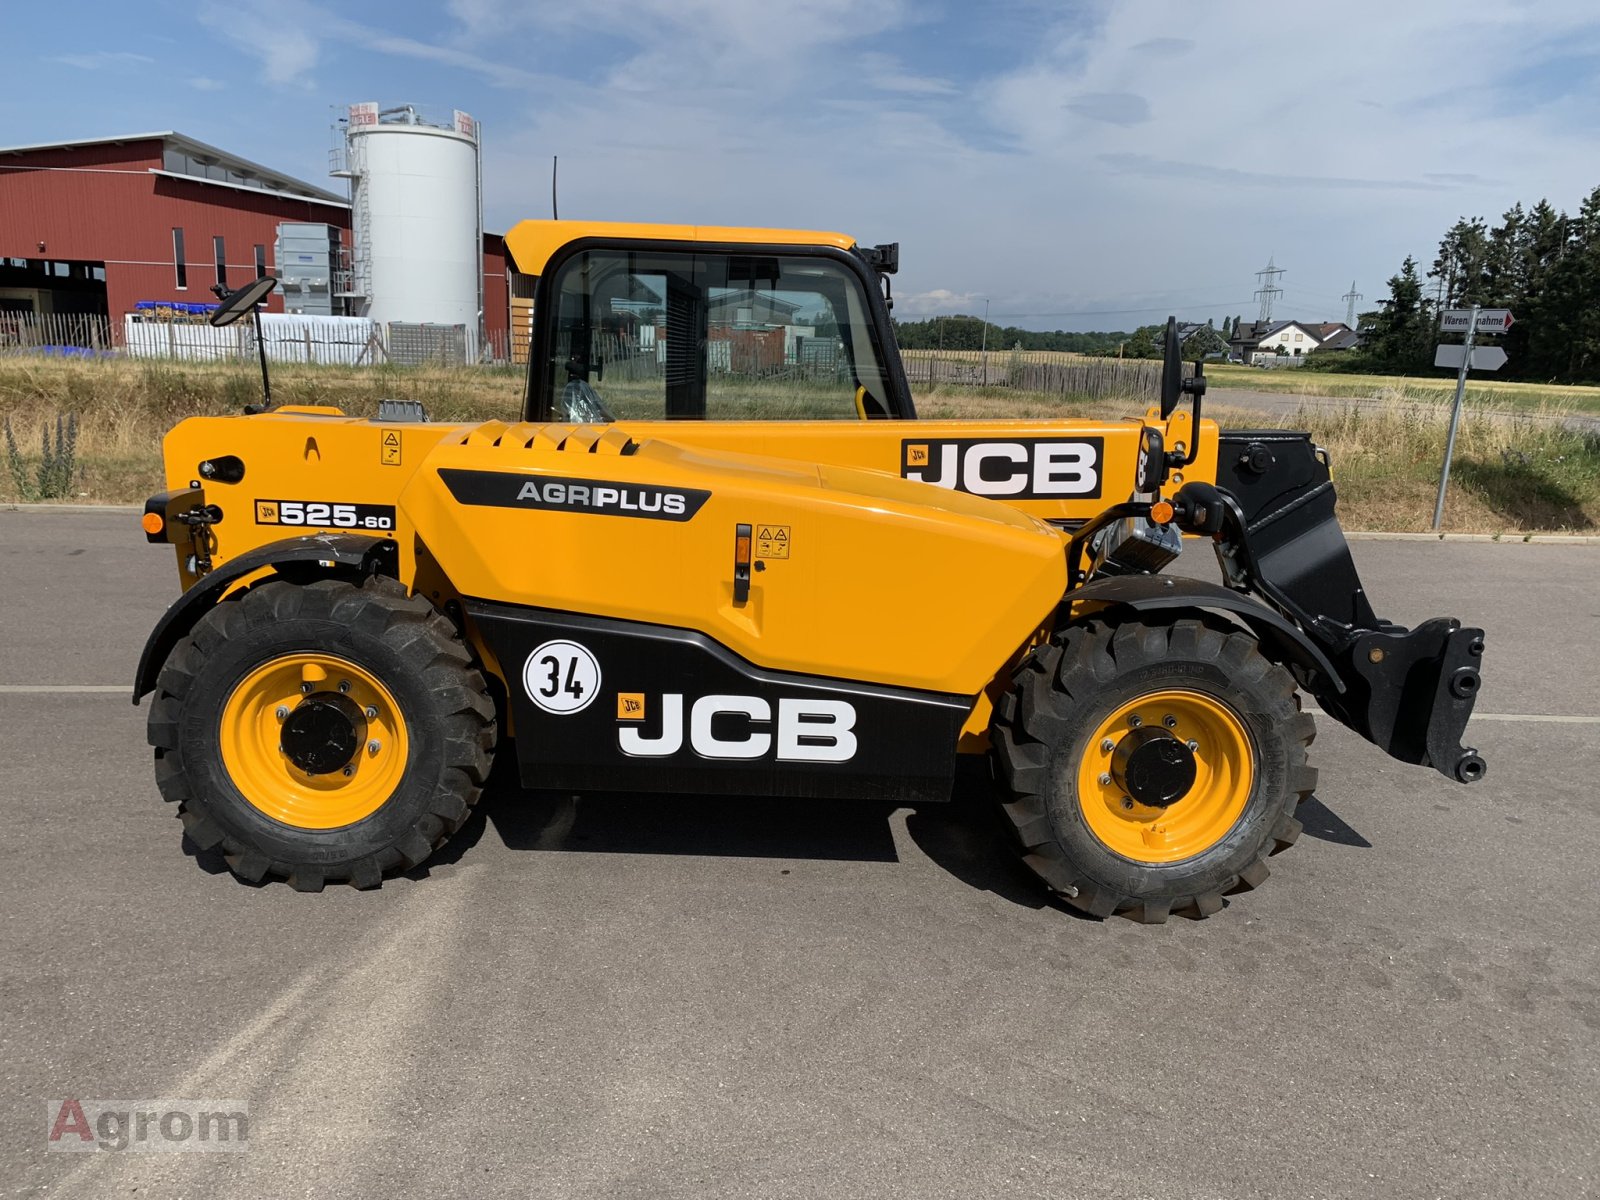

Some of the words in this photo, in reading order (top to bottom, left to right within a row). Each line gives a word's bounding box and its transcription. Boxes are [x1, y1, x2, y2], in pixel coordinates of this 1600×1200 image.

[907, 443, 1097, 495] JCB
[280, 502, 391, 529] 525-60
[516, 481, 686, 515] AGRIPLUS
[539, 654, 584, 699] 34
[624, 699, 641, 712] JCB
[617, 693, 858, 763] JCB
